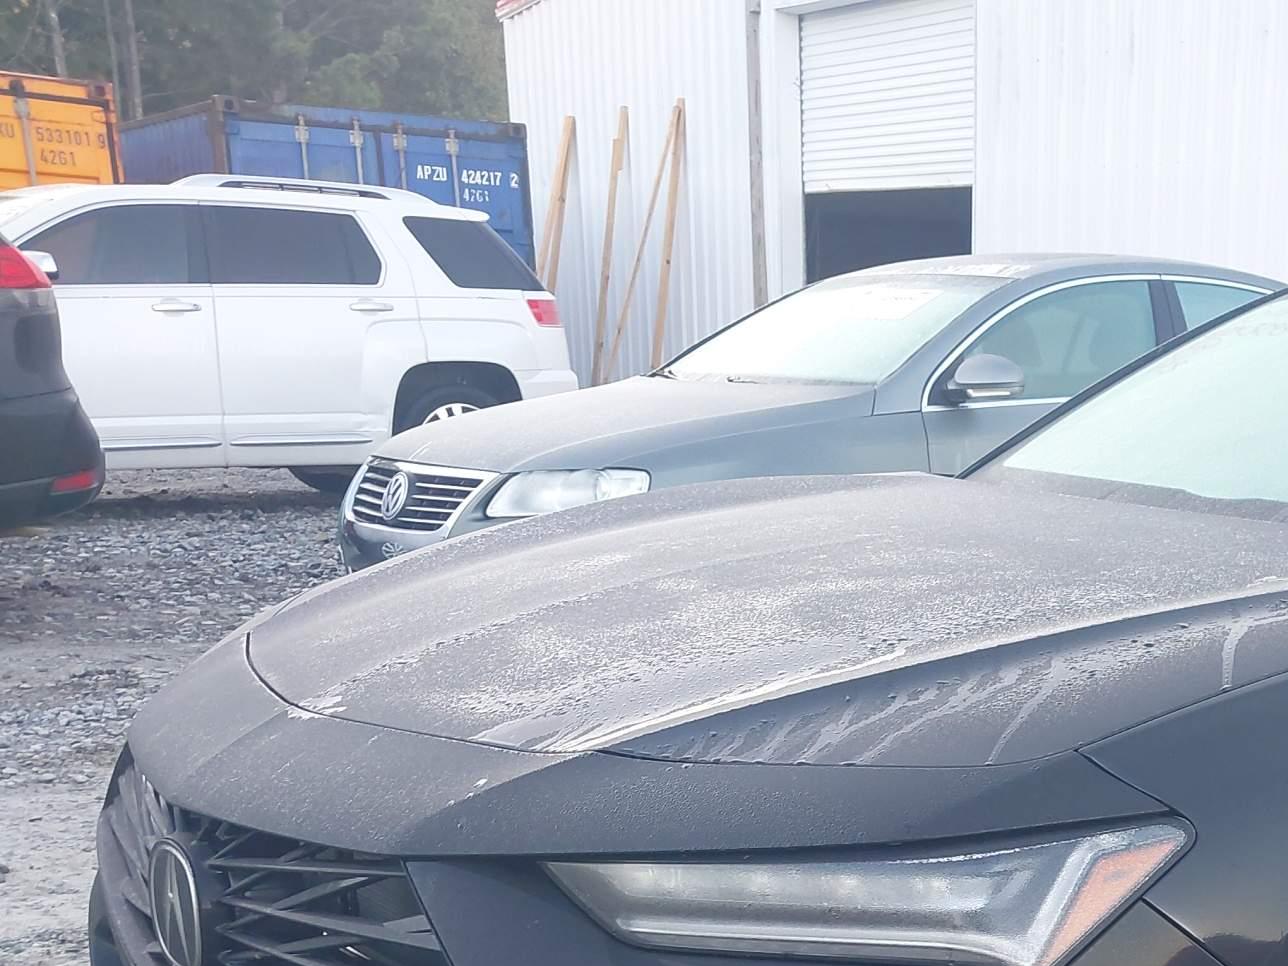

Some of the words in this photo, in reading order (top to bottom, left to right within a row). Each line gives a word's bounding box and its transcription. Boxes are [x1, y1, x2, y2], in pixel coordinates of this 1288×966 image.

[36, 126, 91, 147] 533101
[97, 133, 106, 149] 9
[40, 148, 76, 166] 4261
[416, 164, 448, 181] APZU
[461, 169, 502, 186] 424217
[510, 172, 519, 188] 2
